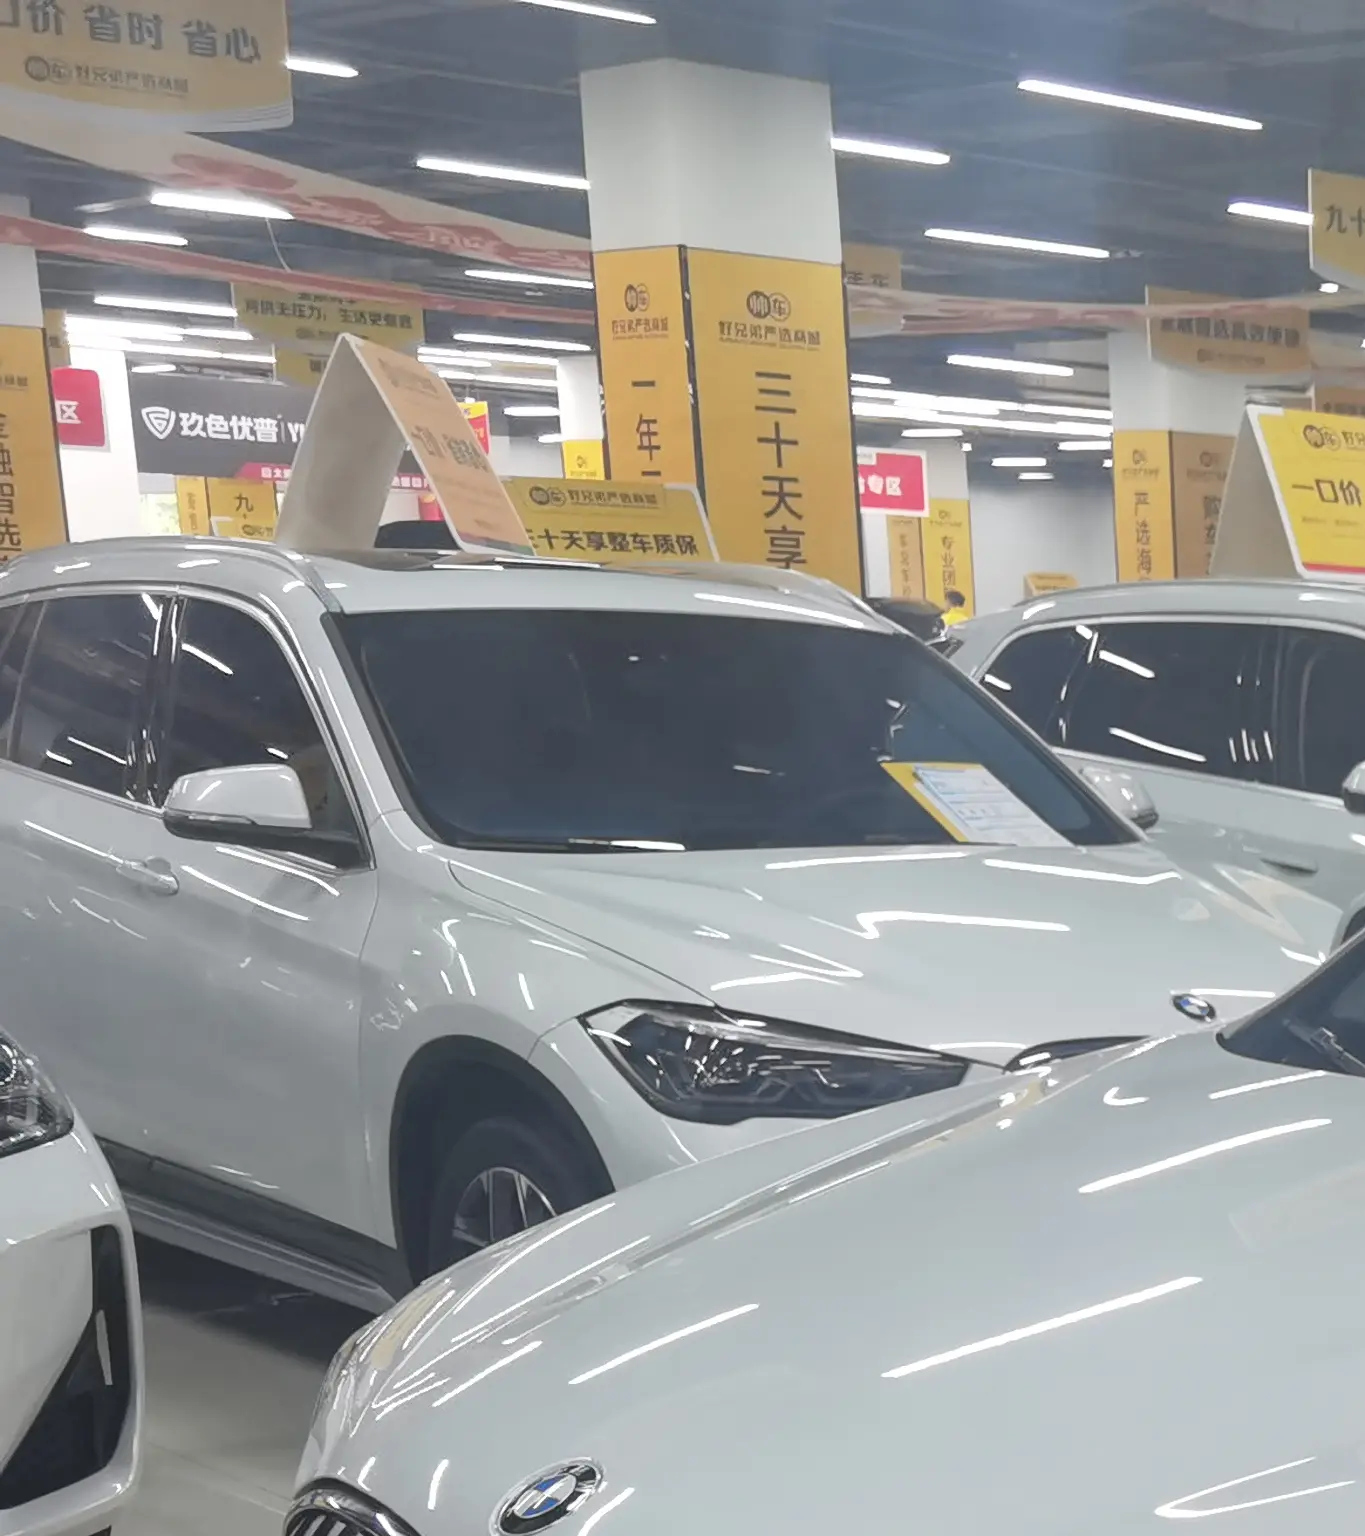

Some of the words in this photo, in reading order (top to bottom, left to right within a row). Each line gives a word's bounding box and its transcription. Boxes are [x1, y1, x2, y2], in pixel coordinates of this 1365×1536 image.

[180, 412, 279, 443] 玖色优普
[755, 371, 808, 570] 三十天享
